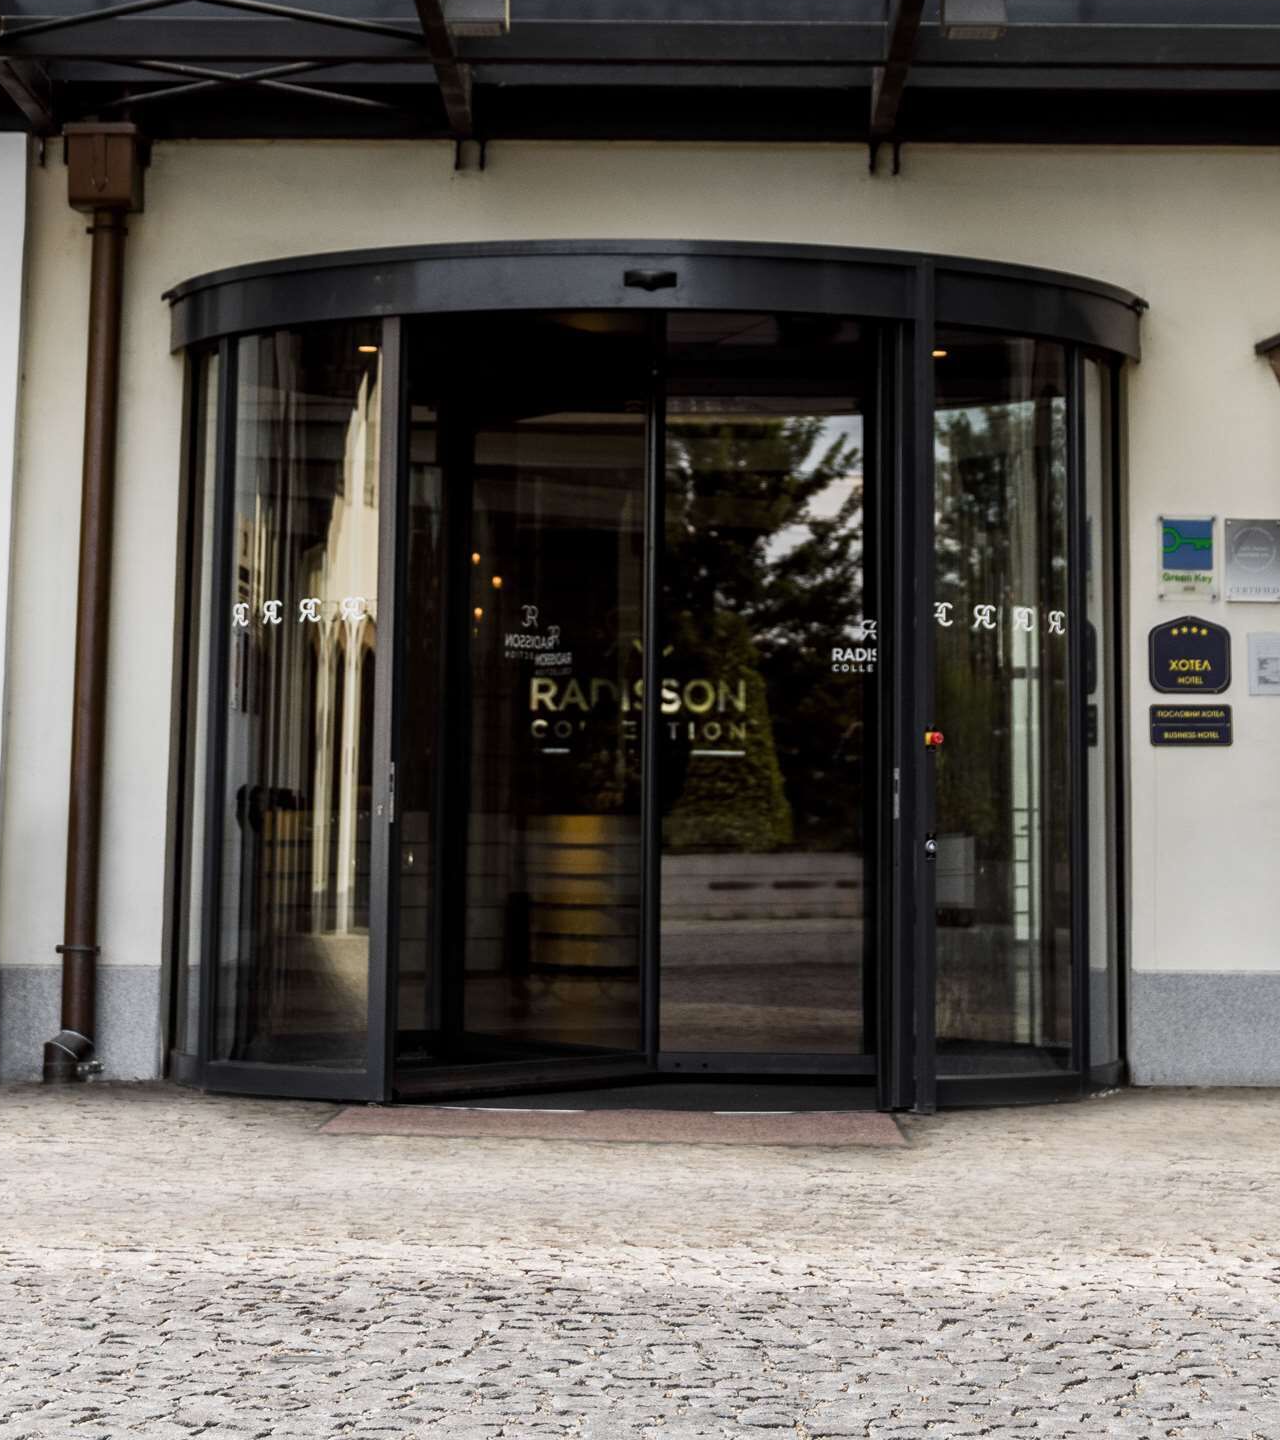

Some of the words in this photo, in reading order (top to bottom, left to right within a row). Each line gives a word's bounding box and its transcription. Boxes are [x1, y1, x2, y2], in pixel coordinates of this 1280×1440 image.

[1169, 659, 1211, 671] ХОТЕЛ
[1177, 676, 1203, 684] HOTEL
[1164, 731, 1196, 739] BUSINESS
[1198, 731, 1219, 739] HOTEL
